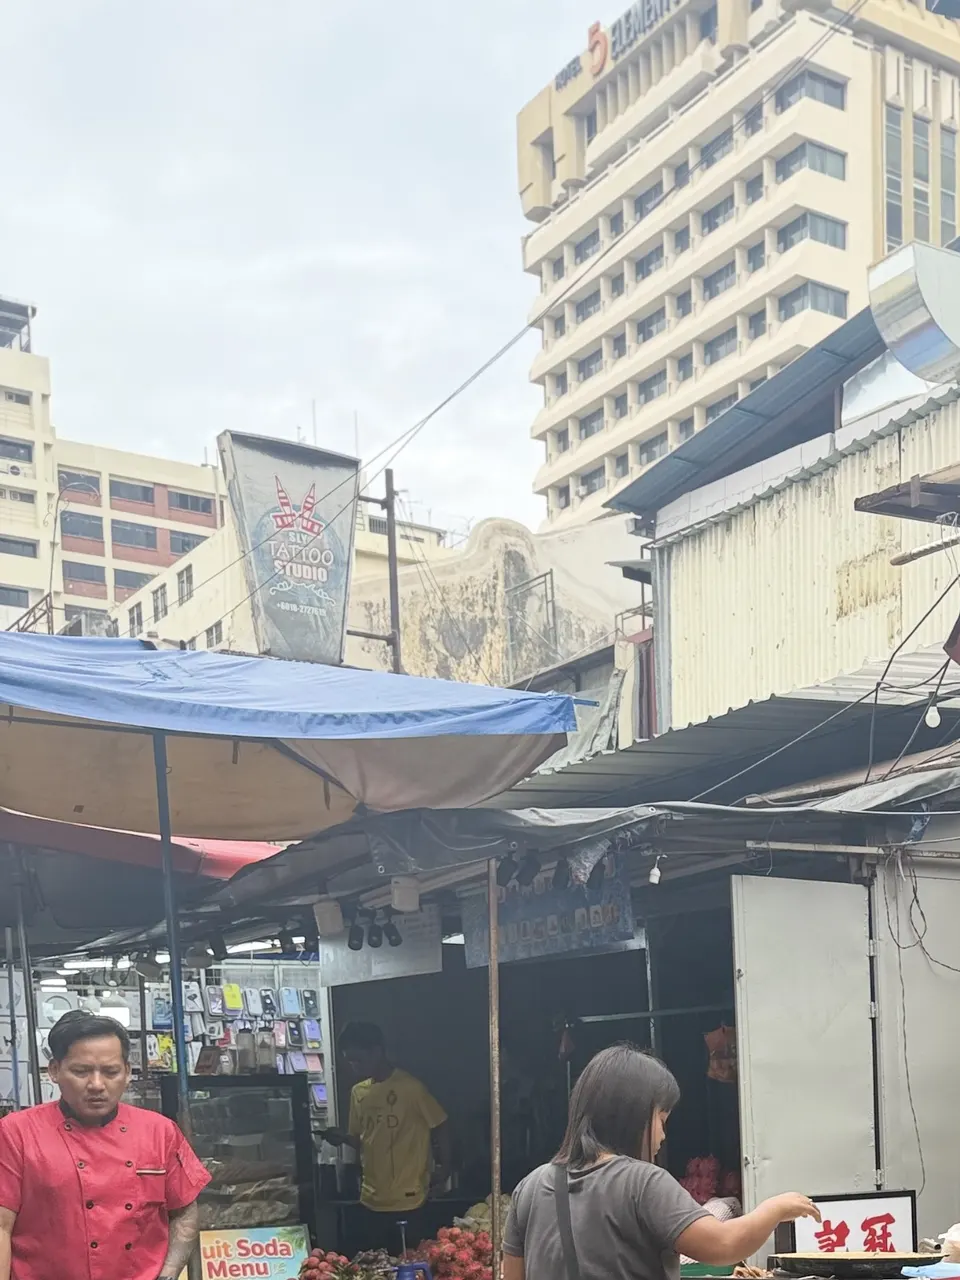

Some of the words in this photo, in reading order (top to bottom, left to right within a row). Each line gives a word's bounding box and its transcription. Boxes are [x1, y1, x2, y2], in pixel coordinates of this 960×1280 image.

[588, 20, 608, 77] 5
[288, 531, 308, 544] SLY
[265, 540, 334, 566] TATTOO
[273, 559, 328, 582] STUDIO
[202, 1240, 232, 1260] uit
[236, 1238, 292, 1257] Soda
[206, 1260, 270, 1280] Menu
